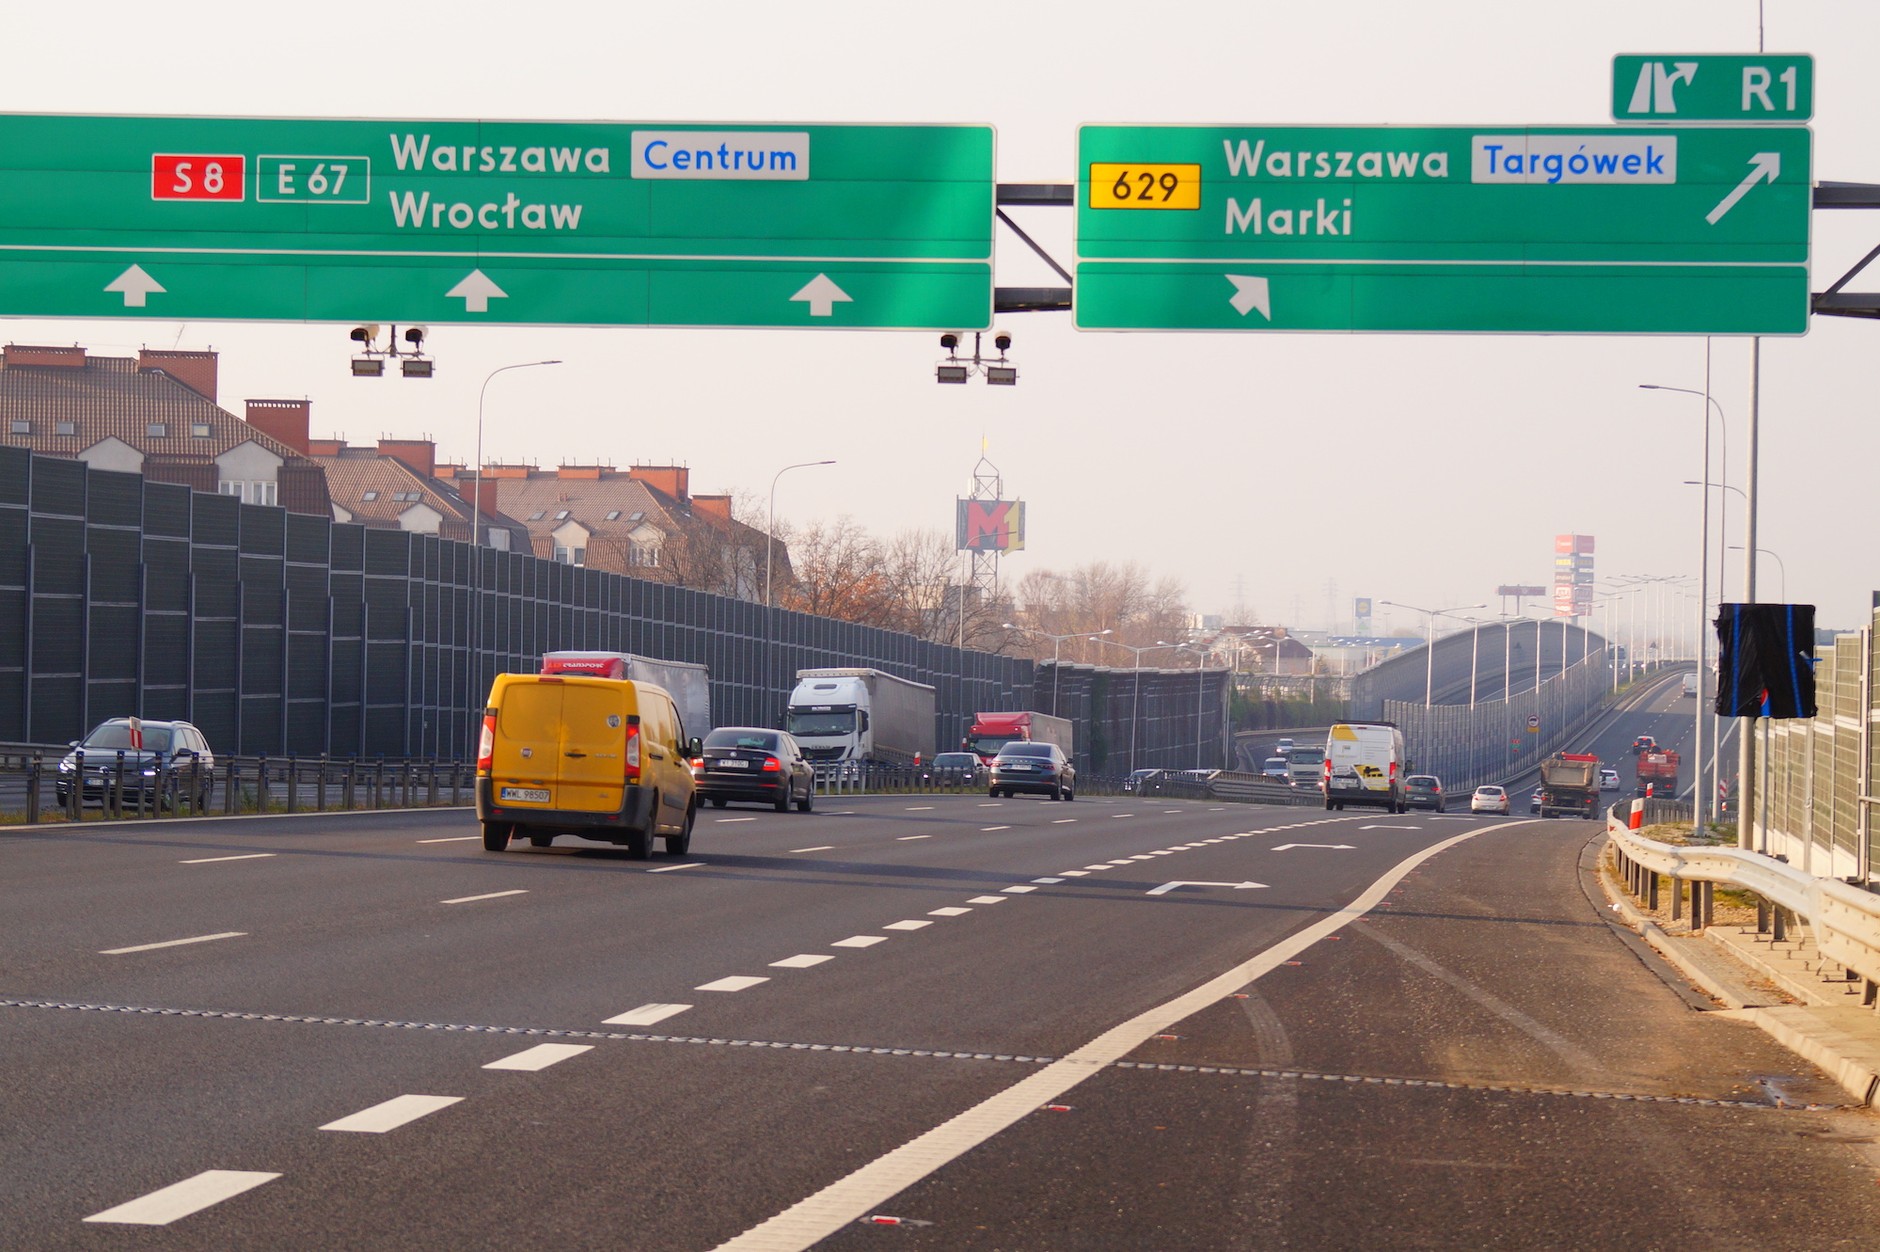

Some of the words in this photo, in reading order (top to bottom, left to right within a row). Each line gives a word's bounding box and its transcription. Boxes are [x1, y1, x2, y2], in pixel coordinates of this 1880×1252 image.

[1742, 66, 1796, 111] R1
[389, 133, 611, 173] Warszawa
[643, 139, 797, 171] Centrum
[1223, 138, 1449, 178] Warszawa
[1484, 143, 1666, 185] Targówek
[307, 163, 348, 196] 67
[1112, 171, 1179, 201] 629
[389, 190, 583, 230] Wrocław
[1225, 197, 1353, 236] Marki
[967, 496, 1024, 557] M1
